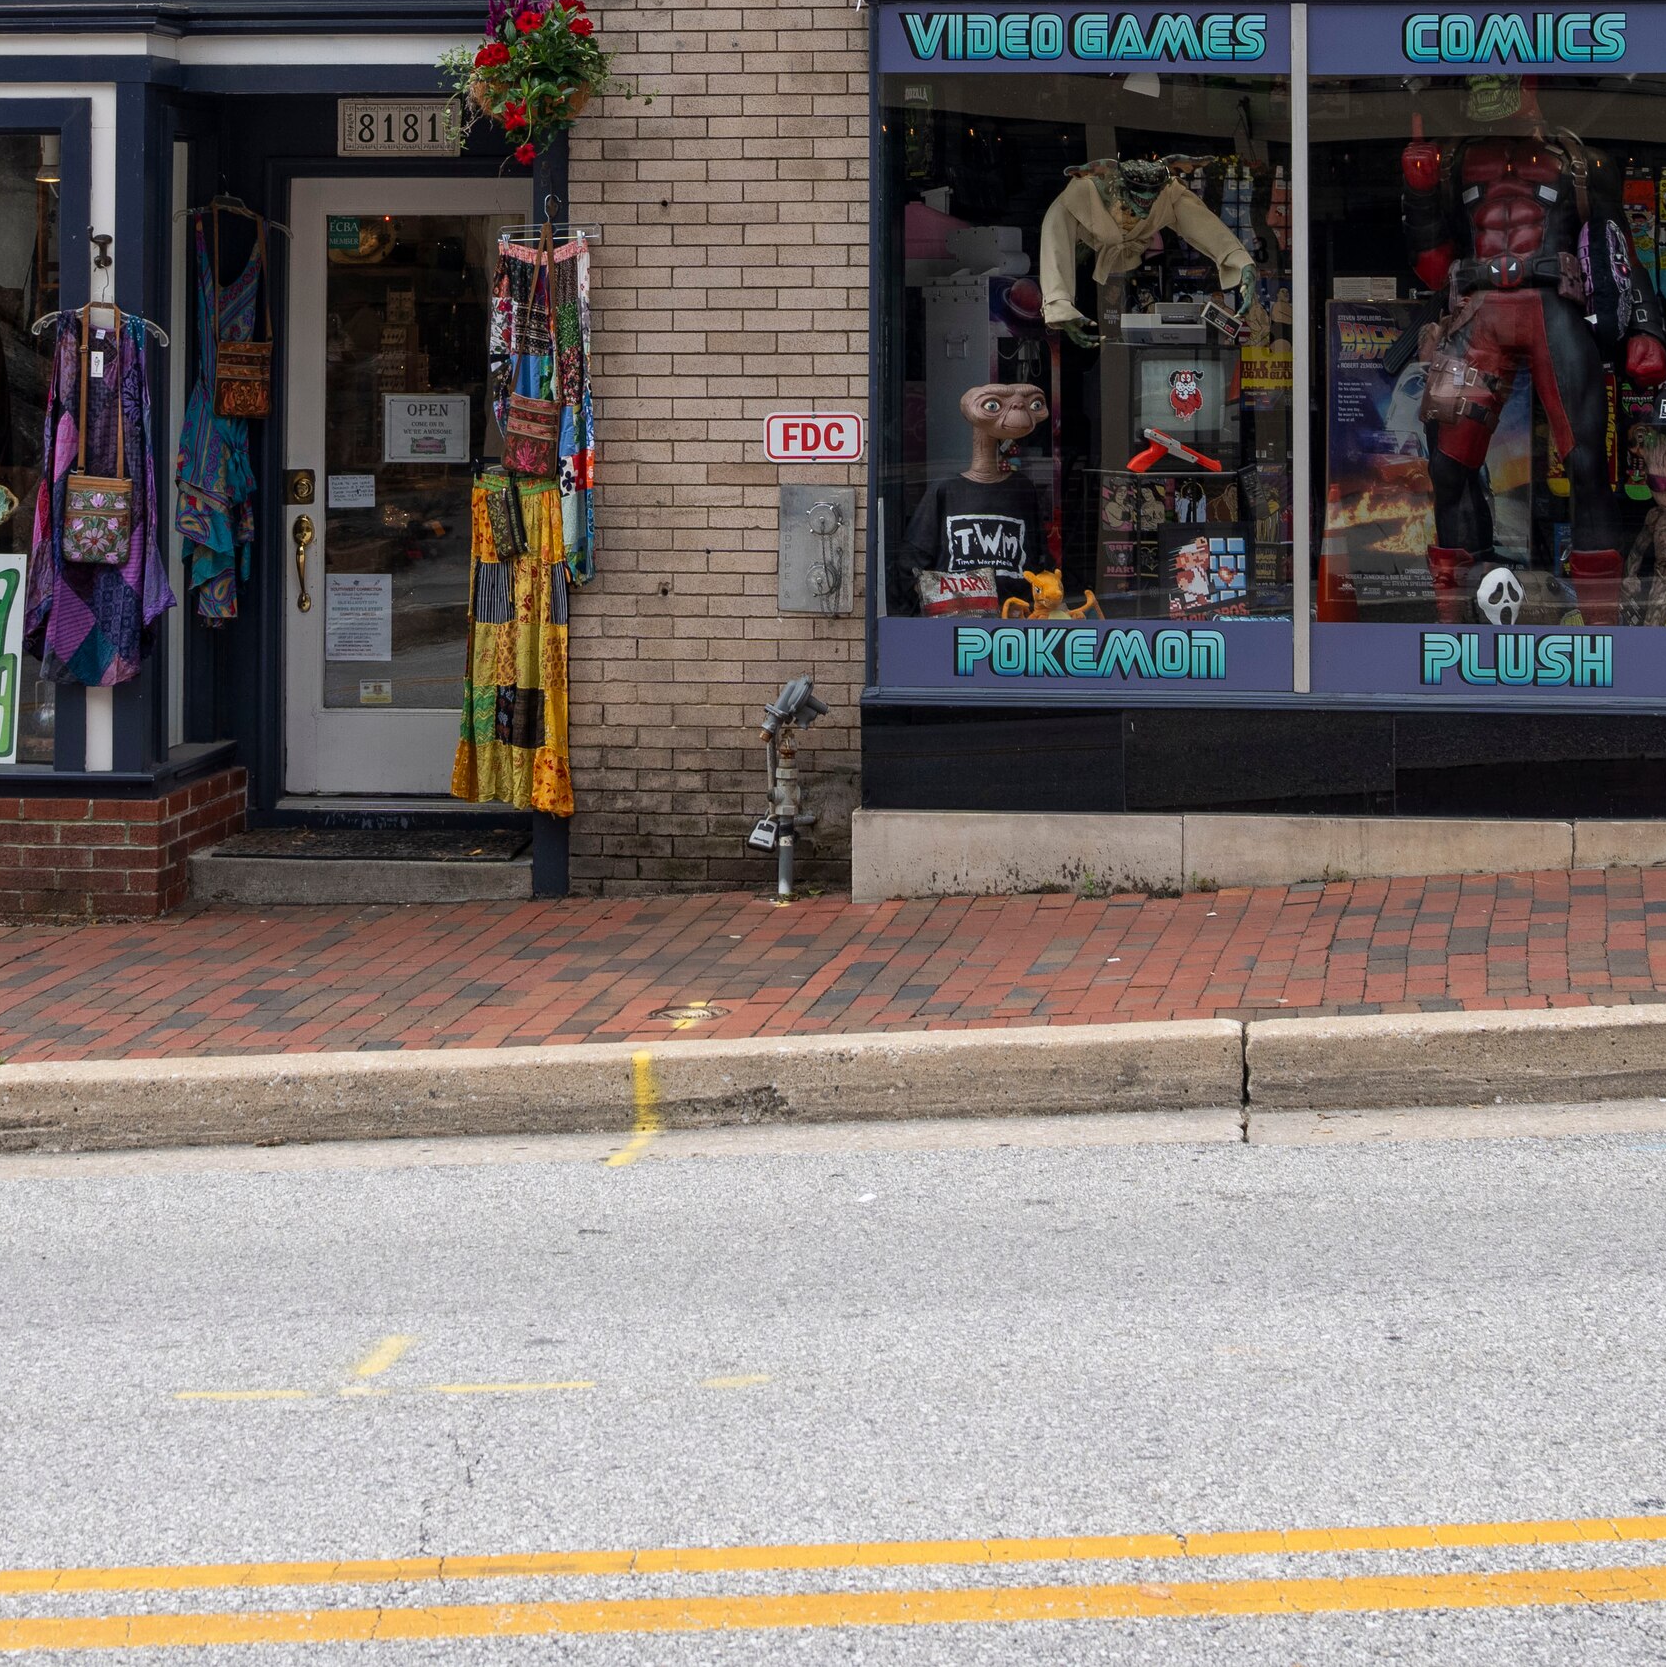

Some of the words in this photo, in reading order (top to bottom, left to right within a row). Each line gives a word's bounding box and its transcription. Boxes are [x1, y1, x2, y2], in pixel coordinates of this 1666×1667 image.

[899, 13, 1064, 62] VIDEO
[1071, 13, 1267, 63] GAMES
[1402, 12, 1628, 64] COMICS
[358, 113, 440, 143] 8181
[329, 221, 359, 232] ECBA
[1338, 322, 1404, 344] BACK
[1341, 344, 1355, 352] TO
[407, 403, 449, 416] OPEN
[782, 422, 845, 452] FDC
[955, 558, 975, 566] Time
[939, 576, 987, 595] ATARI
[954, 625, 1226, 680] POKEMON
[1419, 631, 1614, 687] PLUSH
